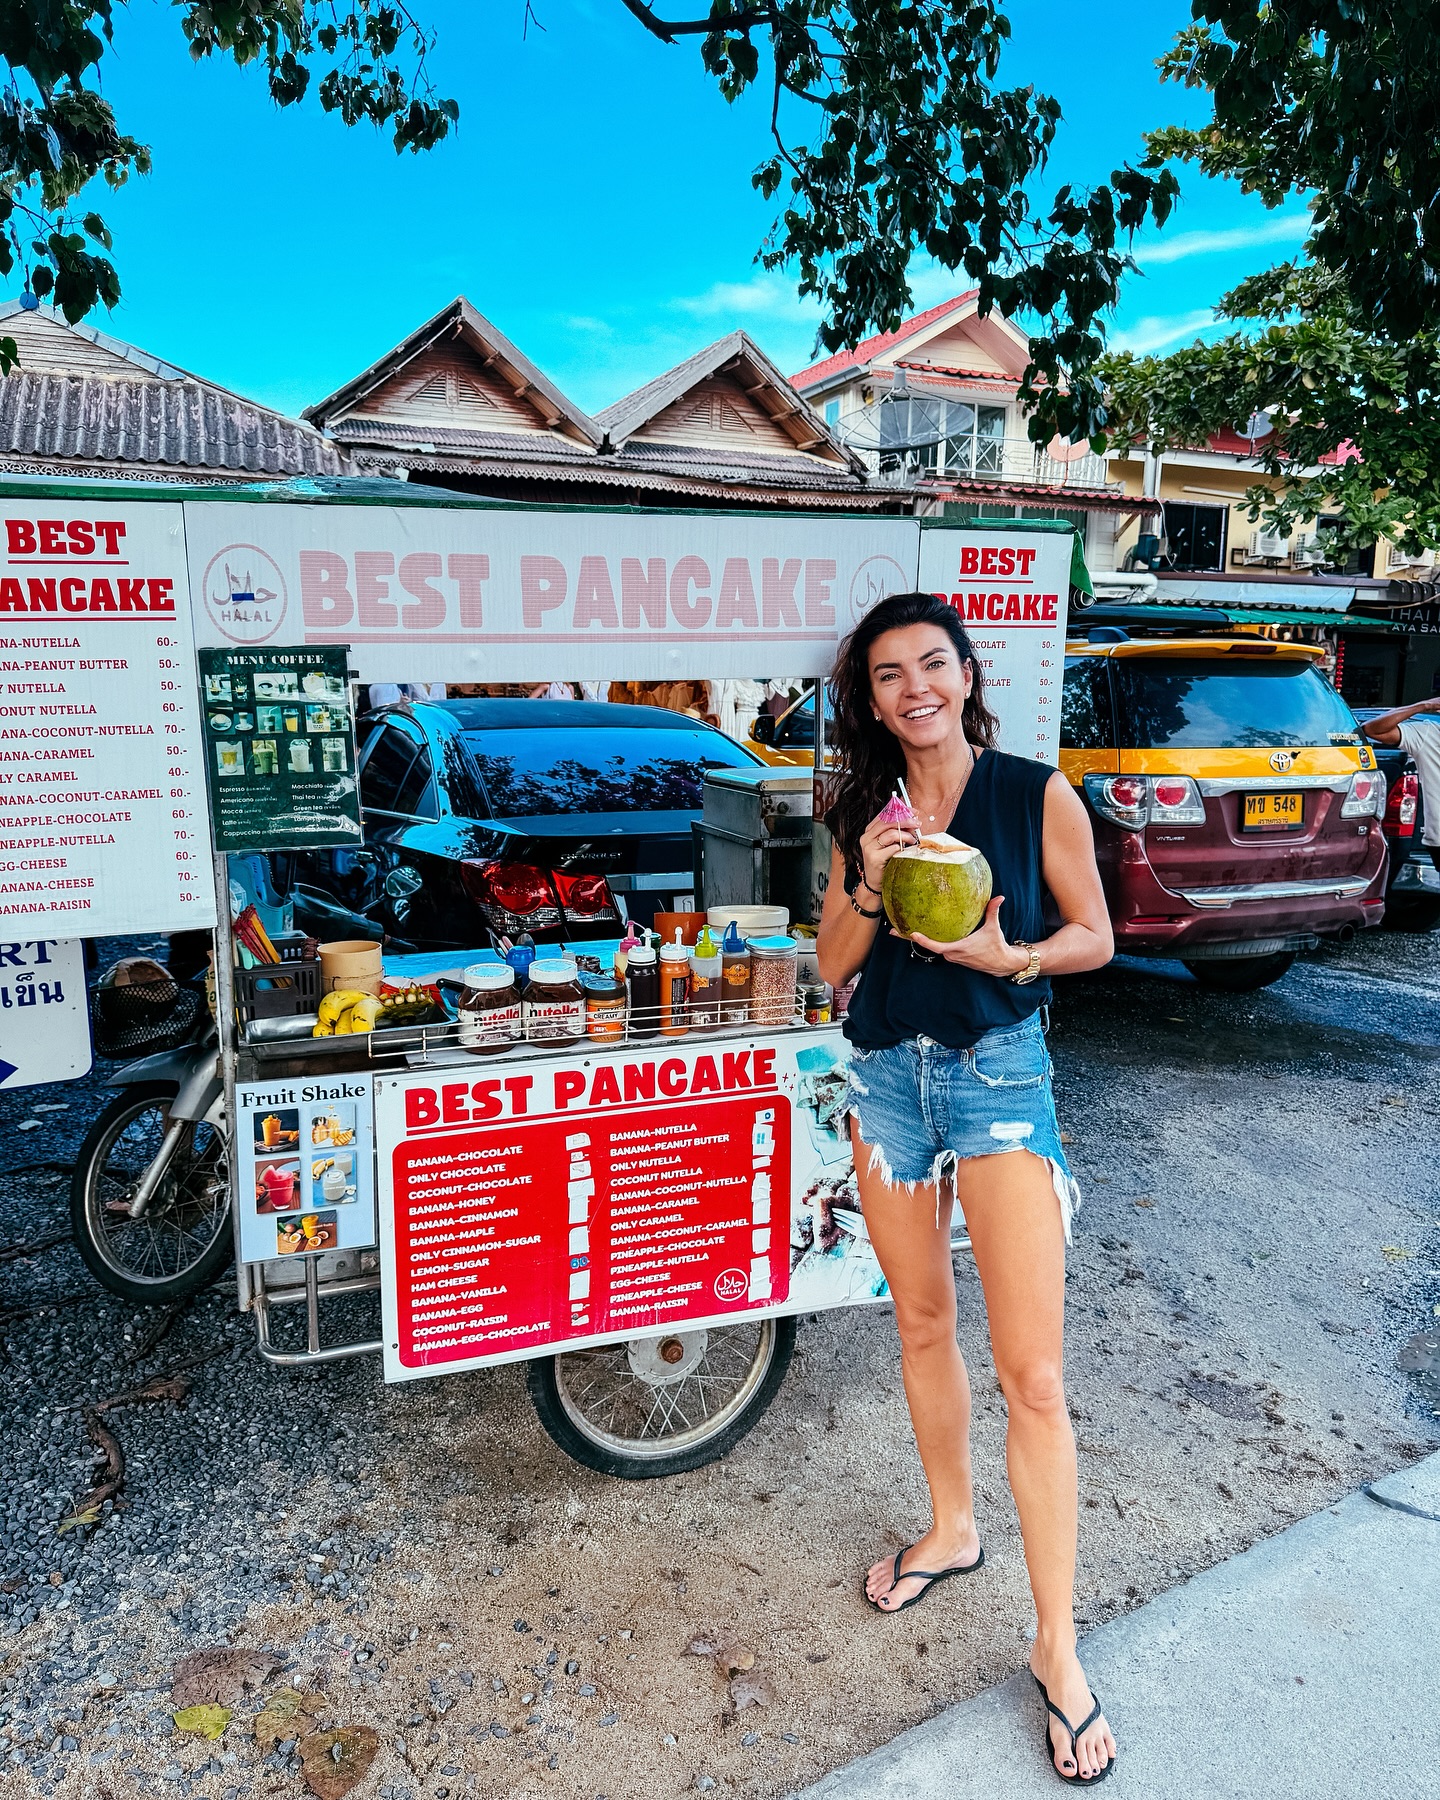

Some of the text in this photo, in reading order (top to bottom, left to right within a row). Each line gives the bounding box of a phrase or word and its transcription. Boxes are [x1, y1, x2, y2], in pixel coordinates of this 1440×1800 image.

[5, 520, 126, 555] BEST
[959, 547, 1036, 576] BEST
[0, 578, 175, 612] ANCAKE
[299, 550, 837, 630] BEST PANCAKE
[221, 610, 272, 622] HALAL
[931, 593, 1058, 621] ANCAKE
[79, 659, 128, 670] BUTTER
[226, 654, 324, 665] MENU COFFEE
[7, 682, 66, 694] NUTELLA
[39, 705, 97, 716] NUTELLA
[17, 771, 78, 783] CARAMEL
[1273, 796, 1296, 813] 548
[223, 829, 261, 837] Cappuccino
[474, 1009, 520, 1027] nutella
[529, 1005, 579, 1019] nutella
[241, 1083, 366, 1108] Fruit Shake
[405, 1048, 776, 1128] BEST PANCAKE
[610, 1123, 697, 1142] BANANA-NUTELLA
[610, 1134, 730, 1157] BANANA-PEANUT BUTTER
[407, 1145, 523, 1169] BANANA-CHOCOLATE
[610, 1155, 682, 1172] ONLY NUTELLA
[408, 1163, 506, 1184] ONLY CHOCOLATE
[610, 1167, 703, 1187] COCONUT NUTELLA
[408, 1175, 532, 1200] COCONUT-CHOCOLATE
[610, 1176, 748, 1202] BANANA-COCONUT-NUTELLA
[409, 1196, 496, 1216] BANANA-HONEY
[610, 1197, 700, 1217] BANANA-CARAMEL
[409, 1208, 518, 1231] BANANA-CINNAMON
[611, 1213, 684, 1232] ONLY CARAMEL
[410, 1227, 495, 1247] BANANA-MAPLE
[610, 1218, 749, 1246] BANANA-COCONUT-CARAMEL
[410, 1235, 541, 1262] ONLY CINNAMON-SUGAR
[610, 1236, 725, 1261] PINEAPPLE-CHOCOLATE
[411, 1258, 490, 1277] LEMON-SUGAR
[610, 1252, 709, 1275] PINEAPPLE-NUTELLA
[411, 1275, 478, 1293] HAM CHEESE
[610, 1272, 671, 1290] EGG-CHEESE
[411, 1285, 508, 1308] BANANA-VANILLA
[610, 1281, 703, 1304] PINEAPPLE-CHEESE
[721, 1288, 741, 1296] HALAL
[412, 1304, 484, 1323] BANANA-EGG
[610, 1298, 688, 1318] BANANA-RAISIN
[412, 1315, 508, 1338] COCONUT-RAISIN
[413, 1322, 551, 1352] BANANA-EGG-CHOCOLATE
